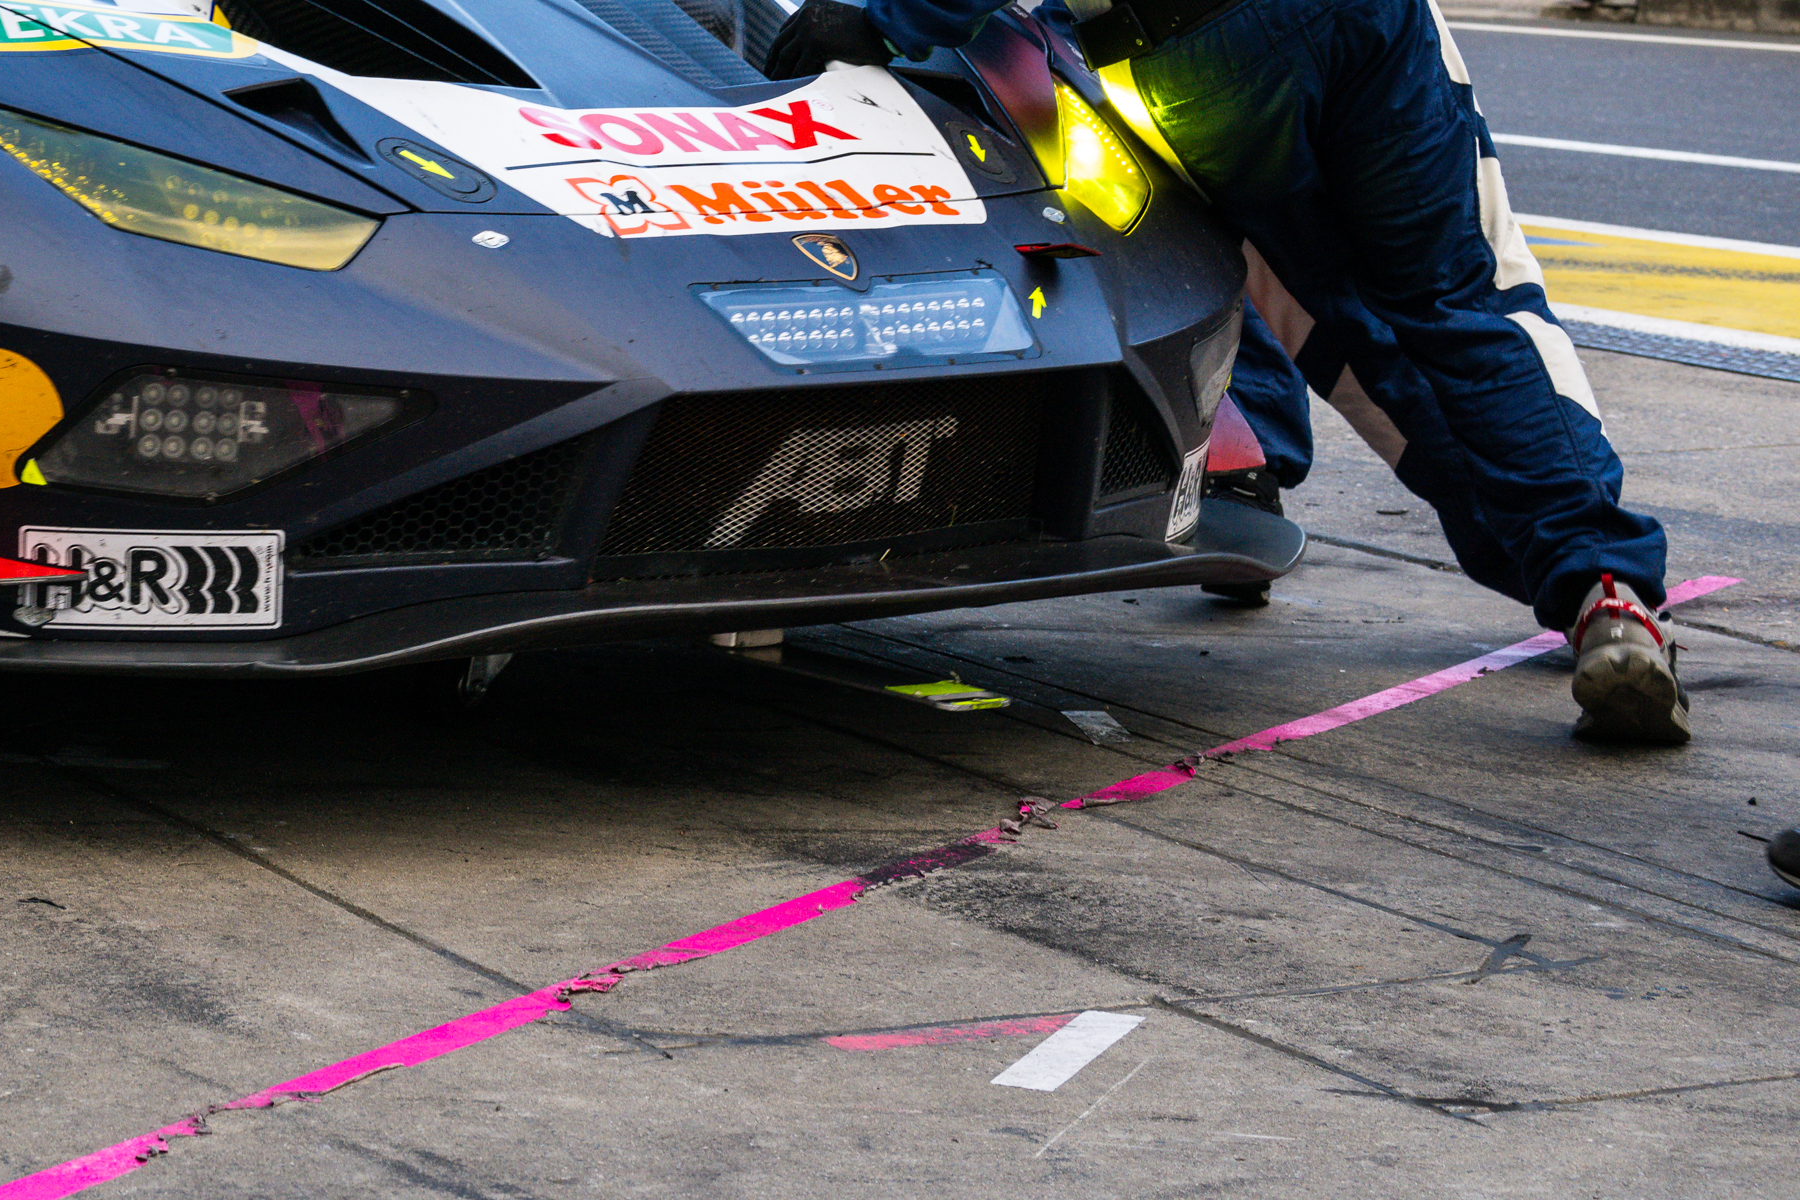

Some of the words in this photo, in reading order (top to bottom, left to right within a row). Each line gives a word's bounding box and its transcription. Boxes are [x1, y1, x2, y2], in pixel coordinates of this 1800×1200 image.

[519, 100, 862, 154] SONAX
[664, 180, 961, 225] Müller
[703, 415, 960, 549] ABT
